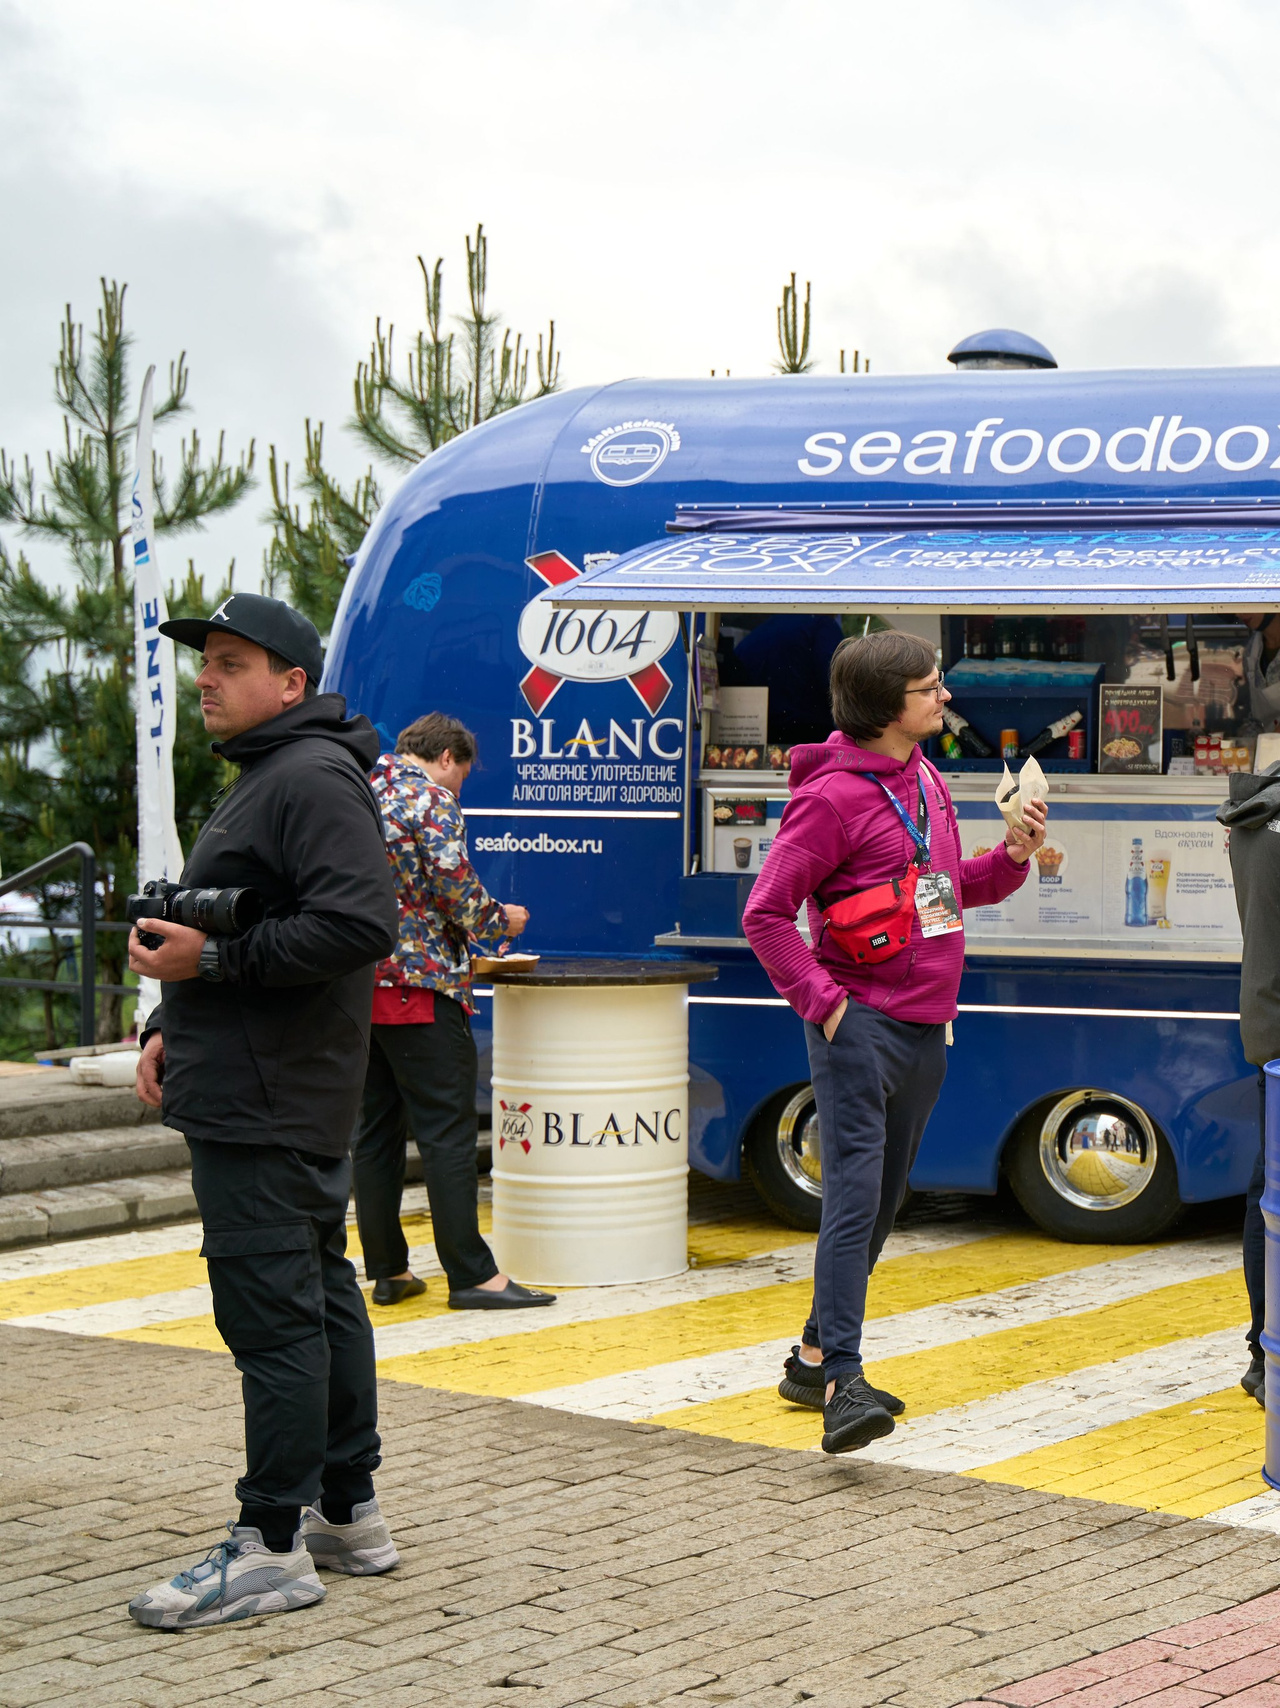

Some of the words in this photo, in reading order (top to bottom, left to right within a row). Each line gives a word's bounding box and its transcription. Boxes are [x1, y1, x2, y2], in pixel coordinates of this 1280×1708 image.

[692, 534, 861, 547] SEA
[672, 545, 855, 557] FOOD
[889, 548, 1045, 560] Первый
[1053, 549, 1076, 557] в
[1088, 547, 1231, 557] России
[639, 554, 838, 573] BOX
[873, 559, 896, 568] с
[905, 557, 1247, 569] морепродуктами
[539, 609, 653, 660] 1664
[1105, 709, 1140, 733] 400
[510, 718, 684, 760] BLANC
[517, 763, 589, 782] ЧРЕЗМЕРНОЕ
[590, 764, 677, 783] УПОТРЕБЛЕНИЕ
[513, 784, 571, 802] АЛКОГОЛЯ
[573, 785, 618, 804] ВРЕДИТ
[620, 785, 682, 804] ЗДОРОВЬЮ
[475, 832, 603, 854] seafoodbox.ru
[1154, 829, 1214, 839] Вдохновлен
[542, 1109, 681, 1147] BLANC
